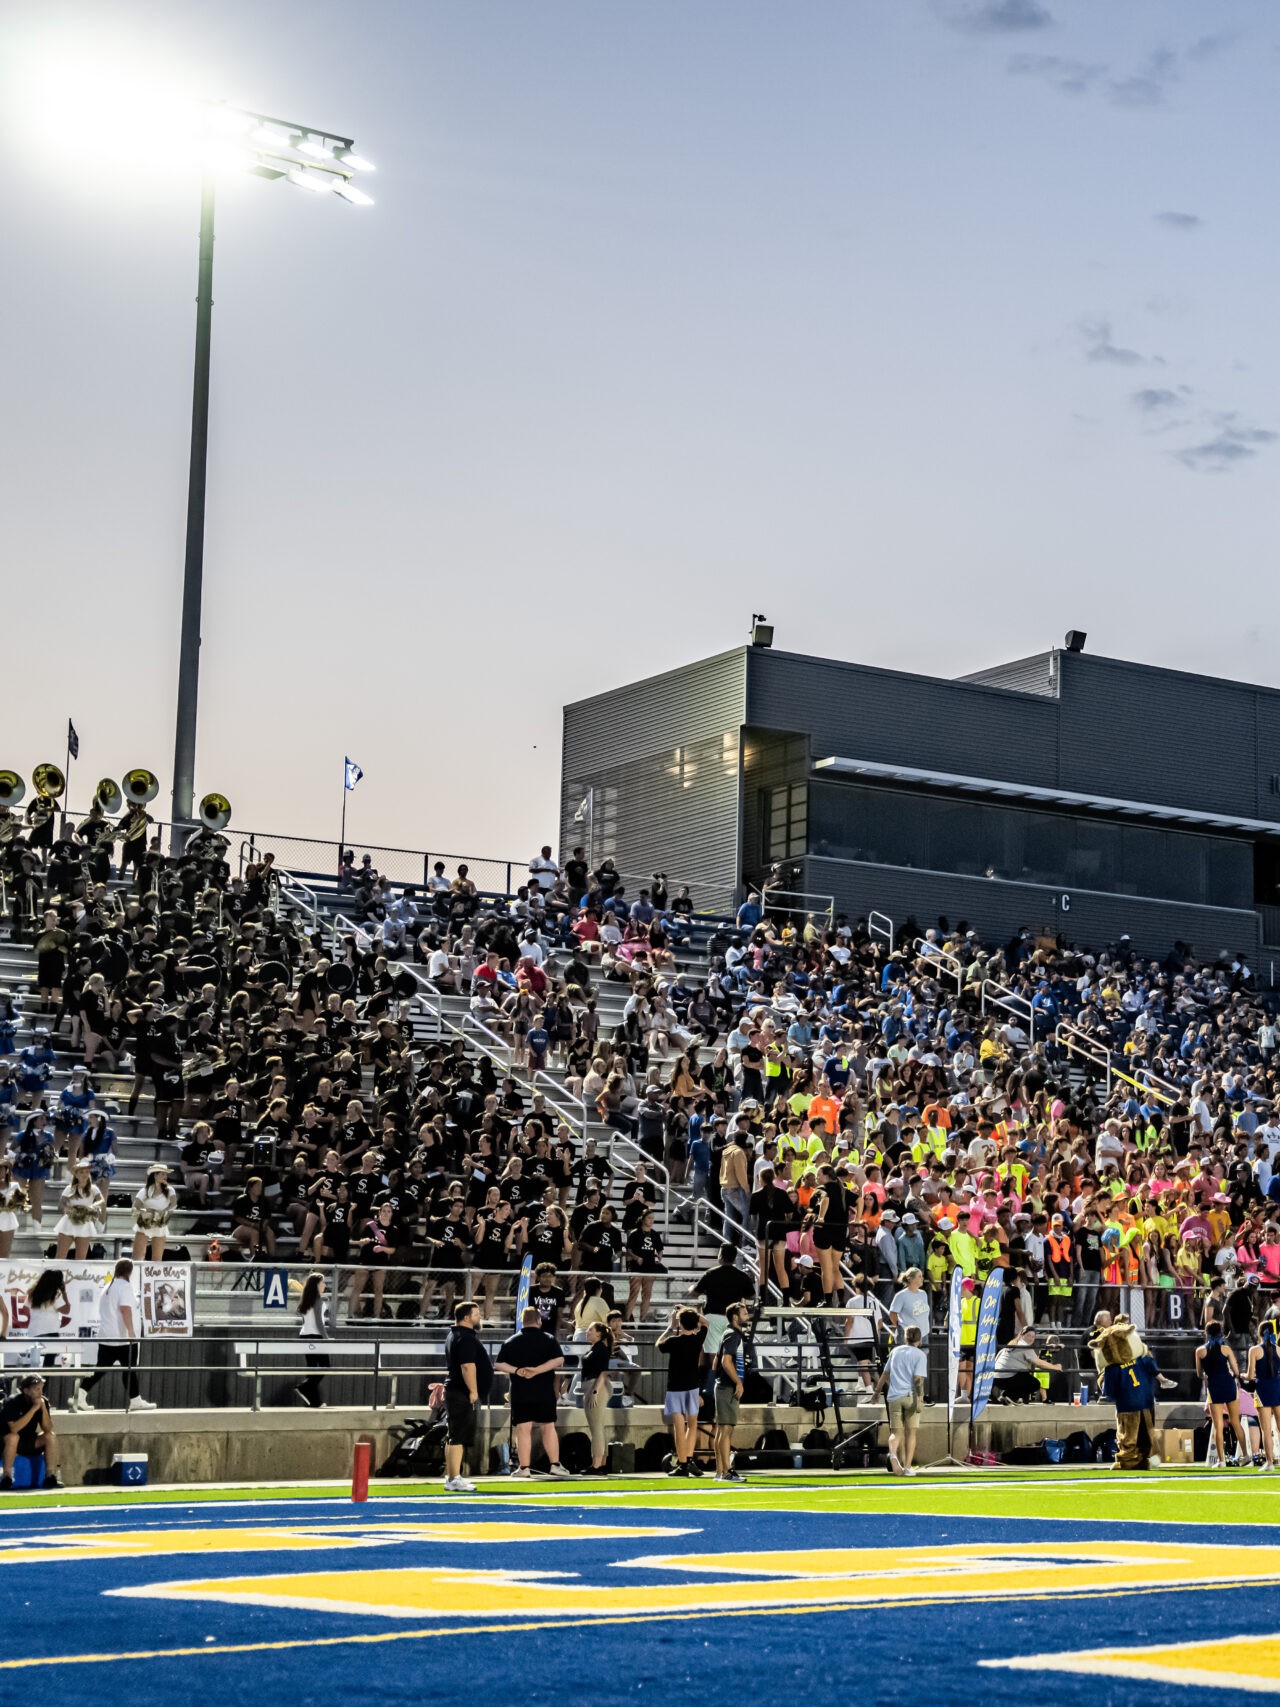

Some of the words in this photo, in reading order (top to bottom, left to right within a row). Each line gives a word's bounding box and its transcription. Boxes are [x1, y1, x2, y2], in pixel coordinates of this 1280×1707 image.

[1061, 894, 1070, 911] C
[266, 1274, 285, 1304] A
[534, 1297, 557, 1306] VENOM
[1170, 1294, 1182, 1320] B
[1129, 1368, 1140, 1387] 1
